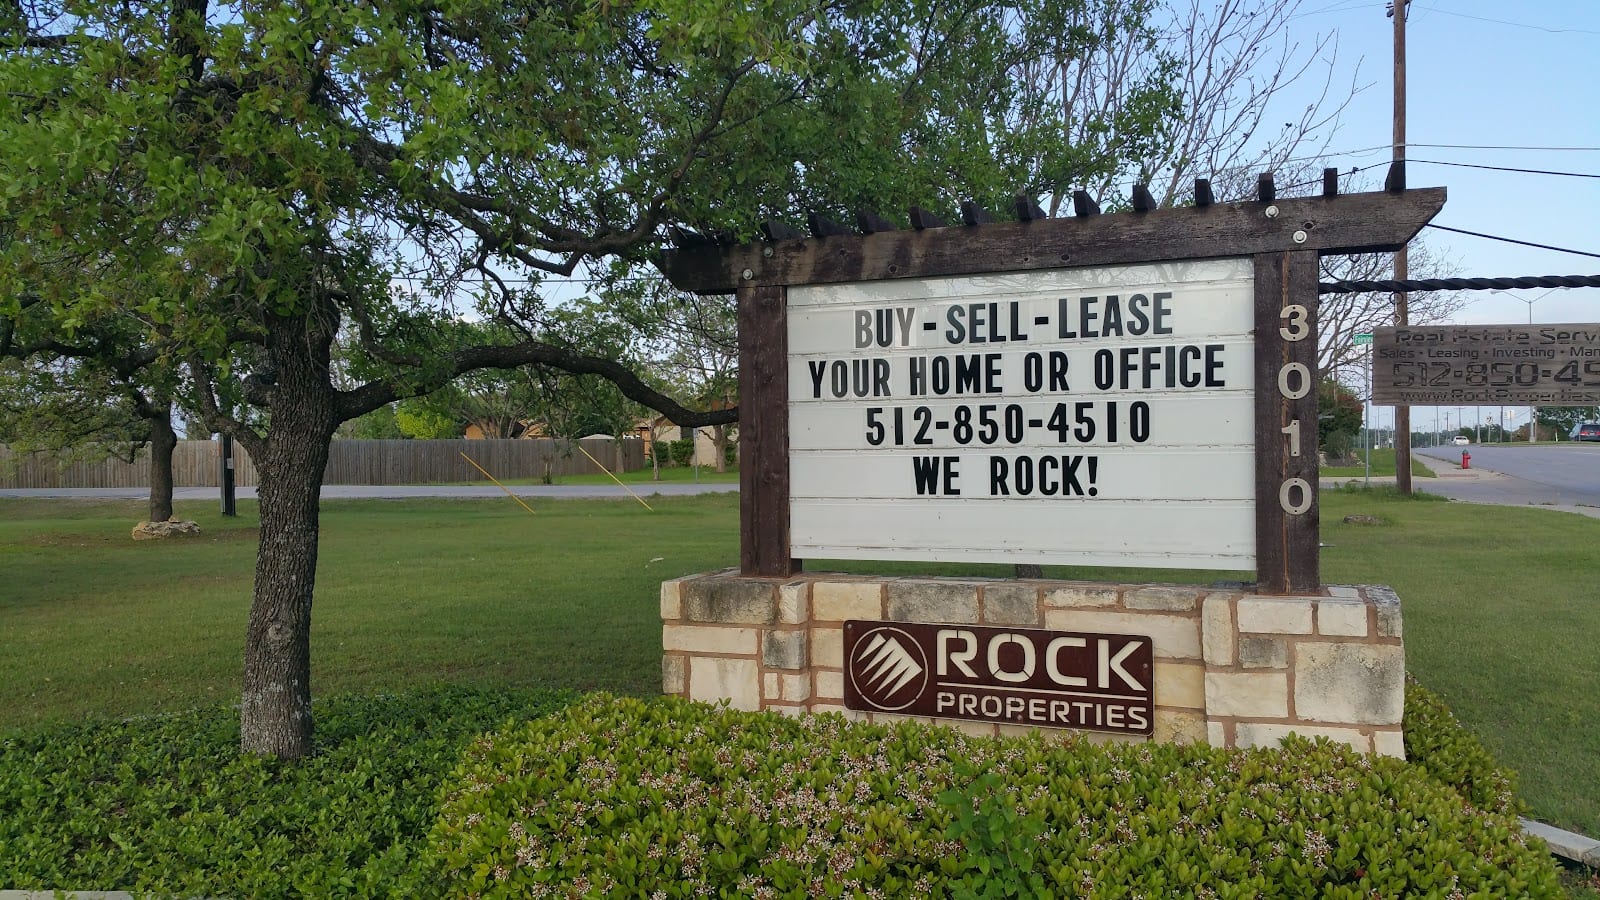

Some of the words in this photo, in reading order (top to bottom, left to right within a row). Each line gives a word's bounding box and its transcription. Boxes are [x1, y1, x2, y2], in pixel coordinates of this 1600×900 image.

[1380, 348, 1415, 359] Sales
[1428, 348, 1479, 360] Leasing
[1492, 347, 1555, 360] Investing
[1395, 329, 1445, 346] Real
[1540, 327, 1600, 345] Serv
[808, 358, 892, 398] YOUR
[909, 353, 1003, 396] HOME
[1024, 350, 1070, 392] OR
[1094, 344, 1226, 390] OFFICE
[866, 401, 1150, 446] 512-850-4510
[913, 456, 961, 496] WE
[990, 455, 1099, 497] ROCK!
[936, 629, 1148, 691] ROCK
[936, 691, 1148, 729] PROPERTIES
